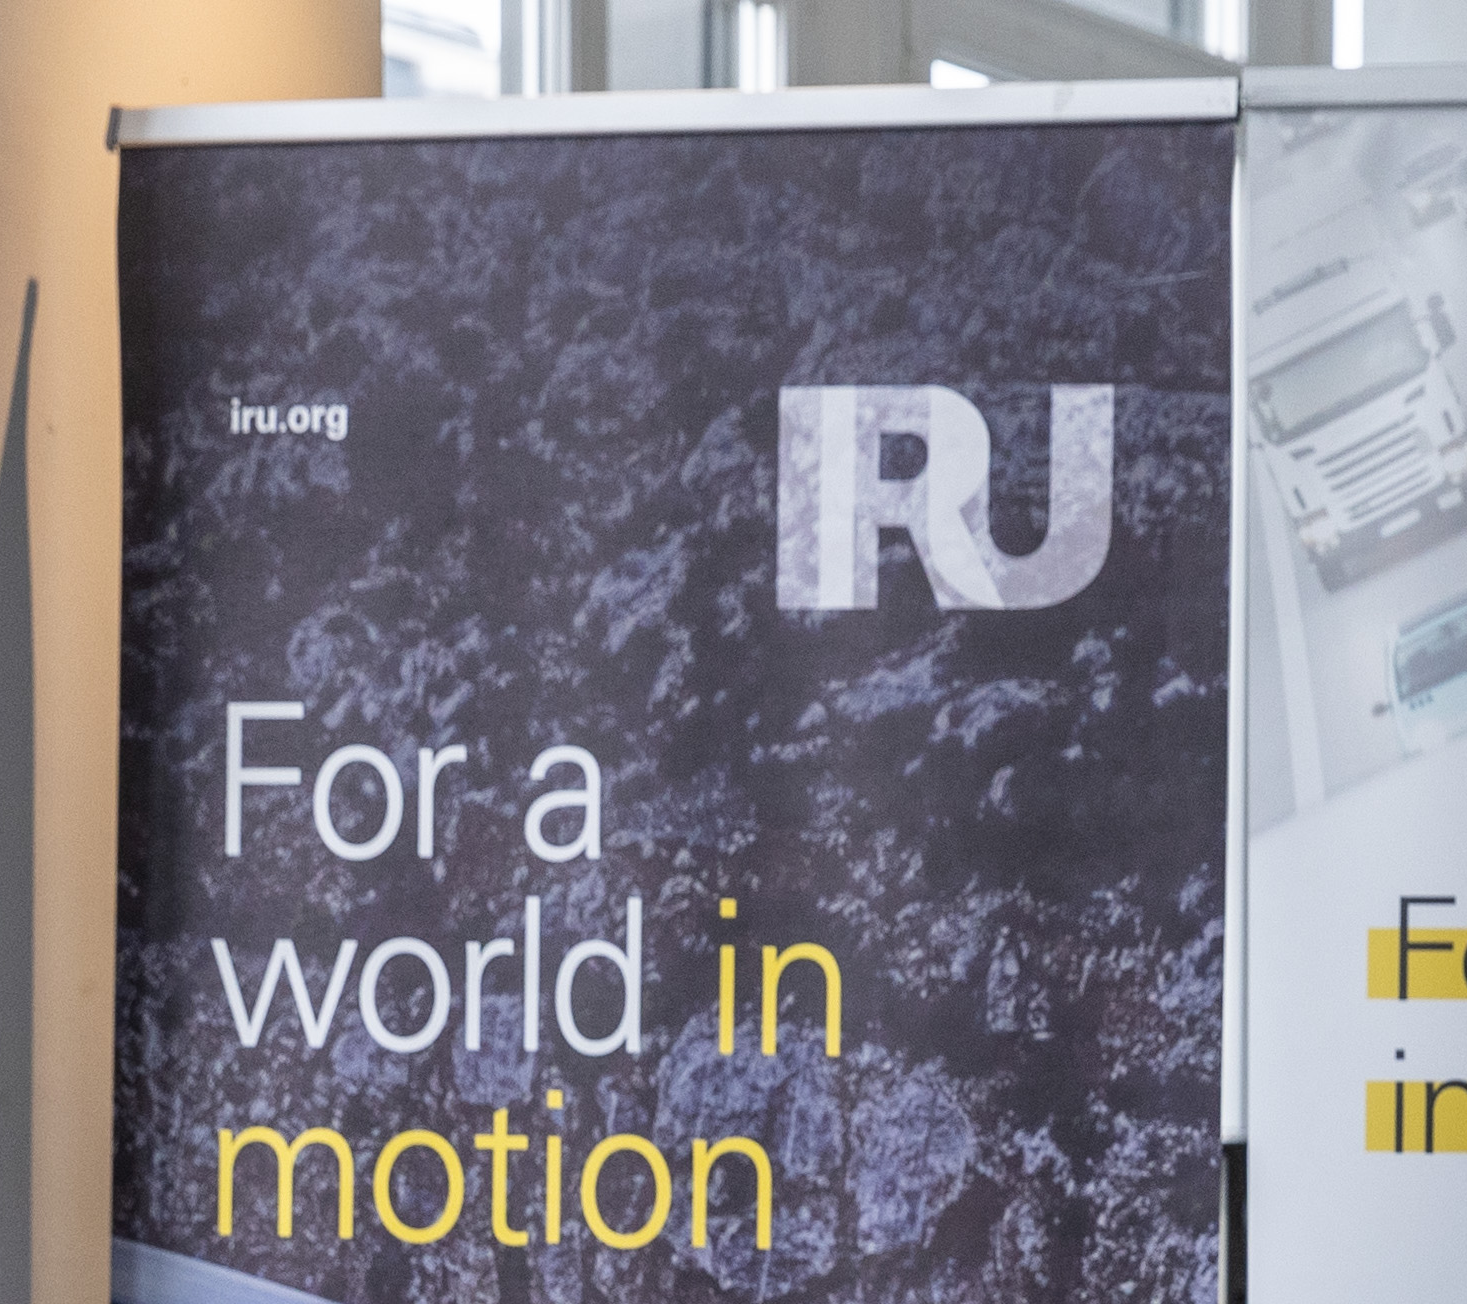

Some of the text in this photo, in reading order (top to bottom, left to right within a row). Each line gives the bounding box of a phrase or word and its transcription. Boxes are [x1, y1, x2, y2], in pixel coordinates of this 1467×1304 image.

[230, 397, 349, 440] iru.org
[776, 383, 1115, 611] IRU
[224, 700, 603, 861] For a
[210, 894, 844, 1058] world in
[216, 1088, 774, 1251] motion
